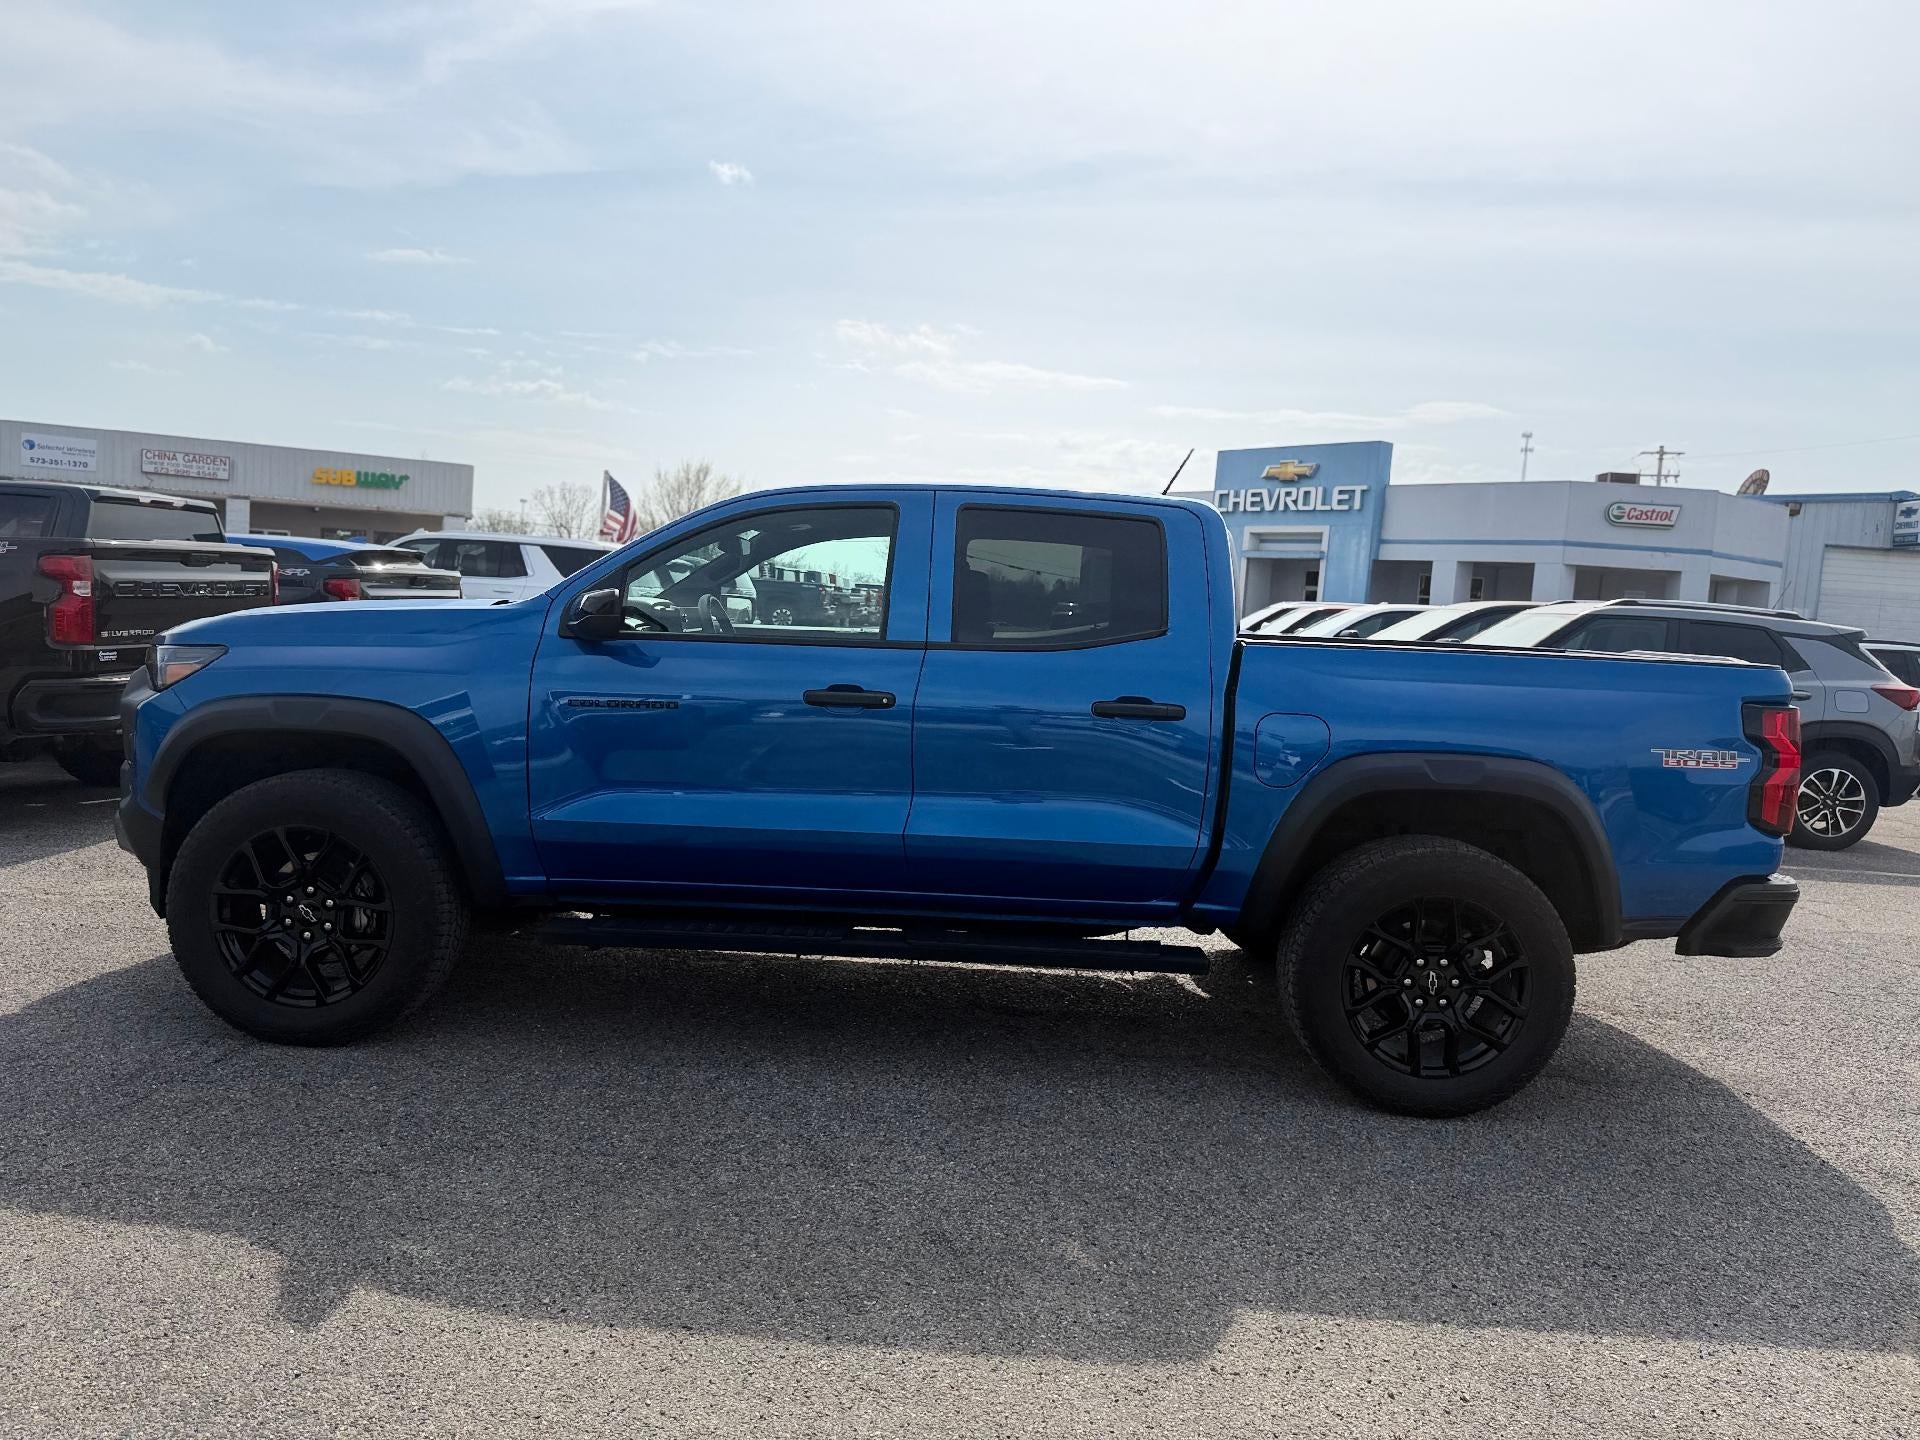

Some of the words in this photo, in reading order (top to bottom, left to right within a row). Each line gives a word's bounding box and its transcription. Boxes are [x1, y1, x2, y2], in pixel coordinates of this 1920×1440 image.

[29, 456, 88, 468] 573-351-1370
[145, 449, 178, 461] CHINA
[182, 454, 227, 466] GARDEN
[1214, 485, 1369, 512] CHEVROLET
[1626, 507, 1674, 522] Castrol
[114, 581, 268, 597] CHEVROLET
[100, 629, 155, 638] SILVERADO
[567, 699, 679, 710] COLORADO
[1651, 749, 1750, 762] TRAIL
[1663, 759, 1738, 770] BOSS
